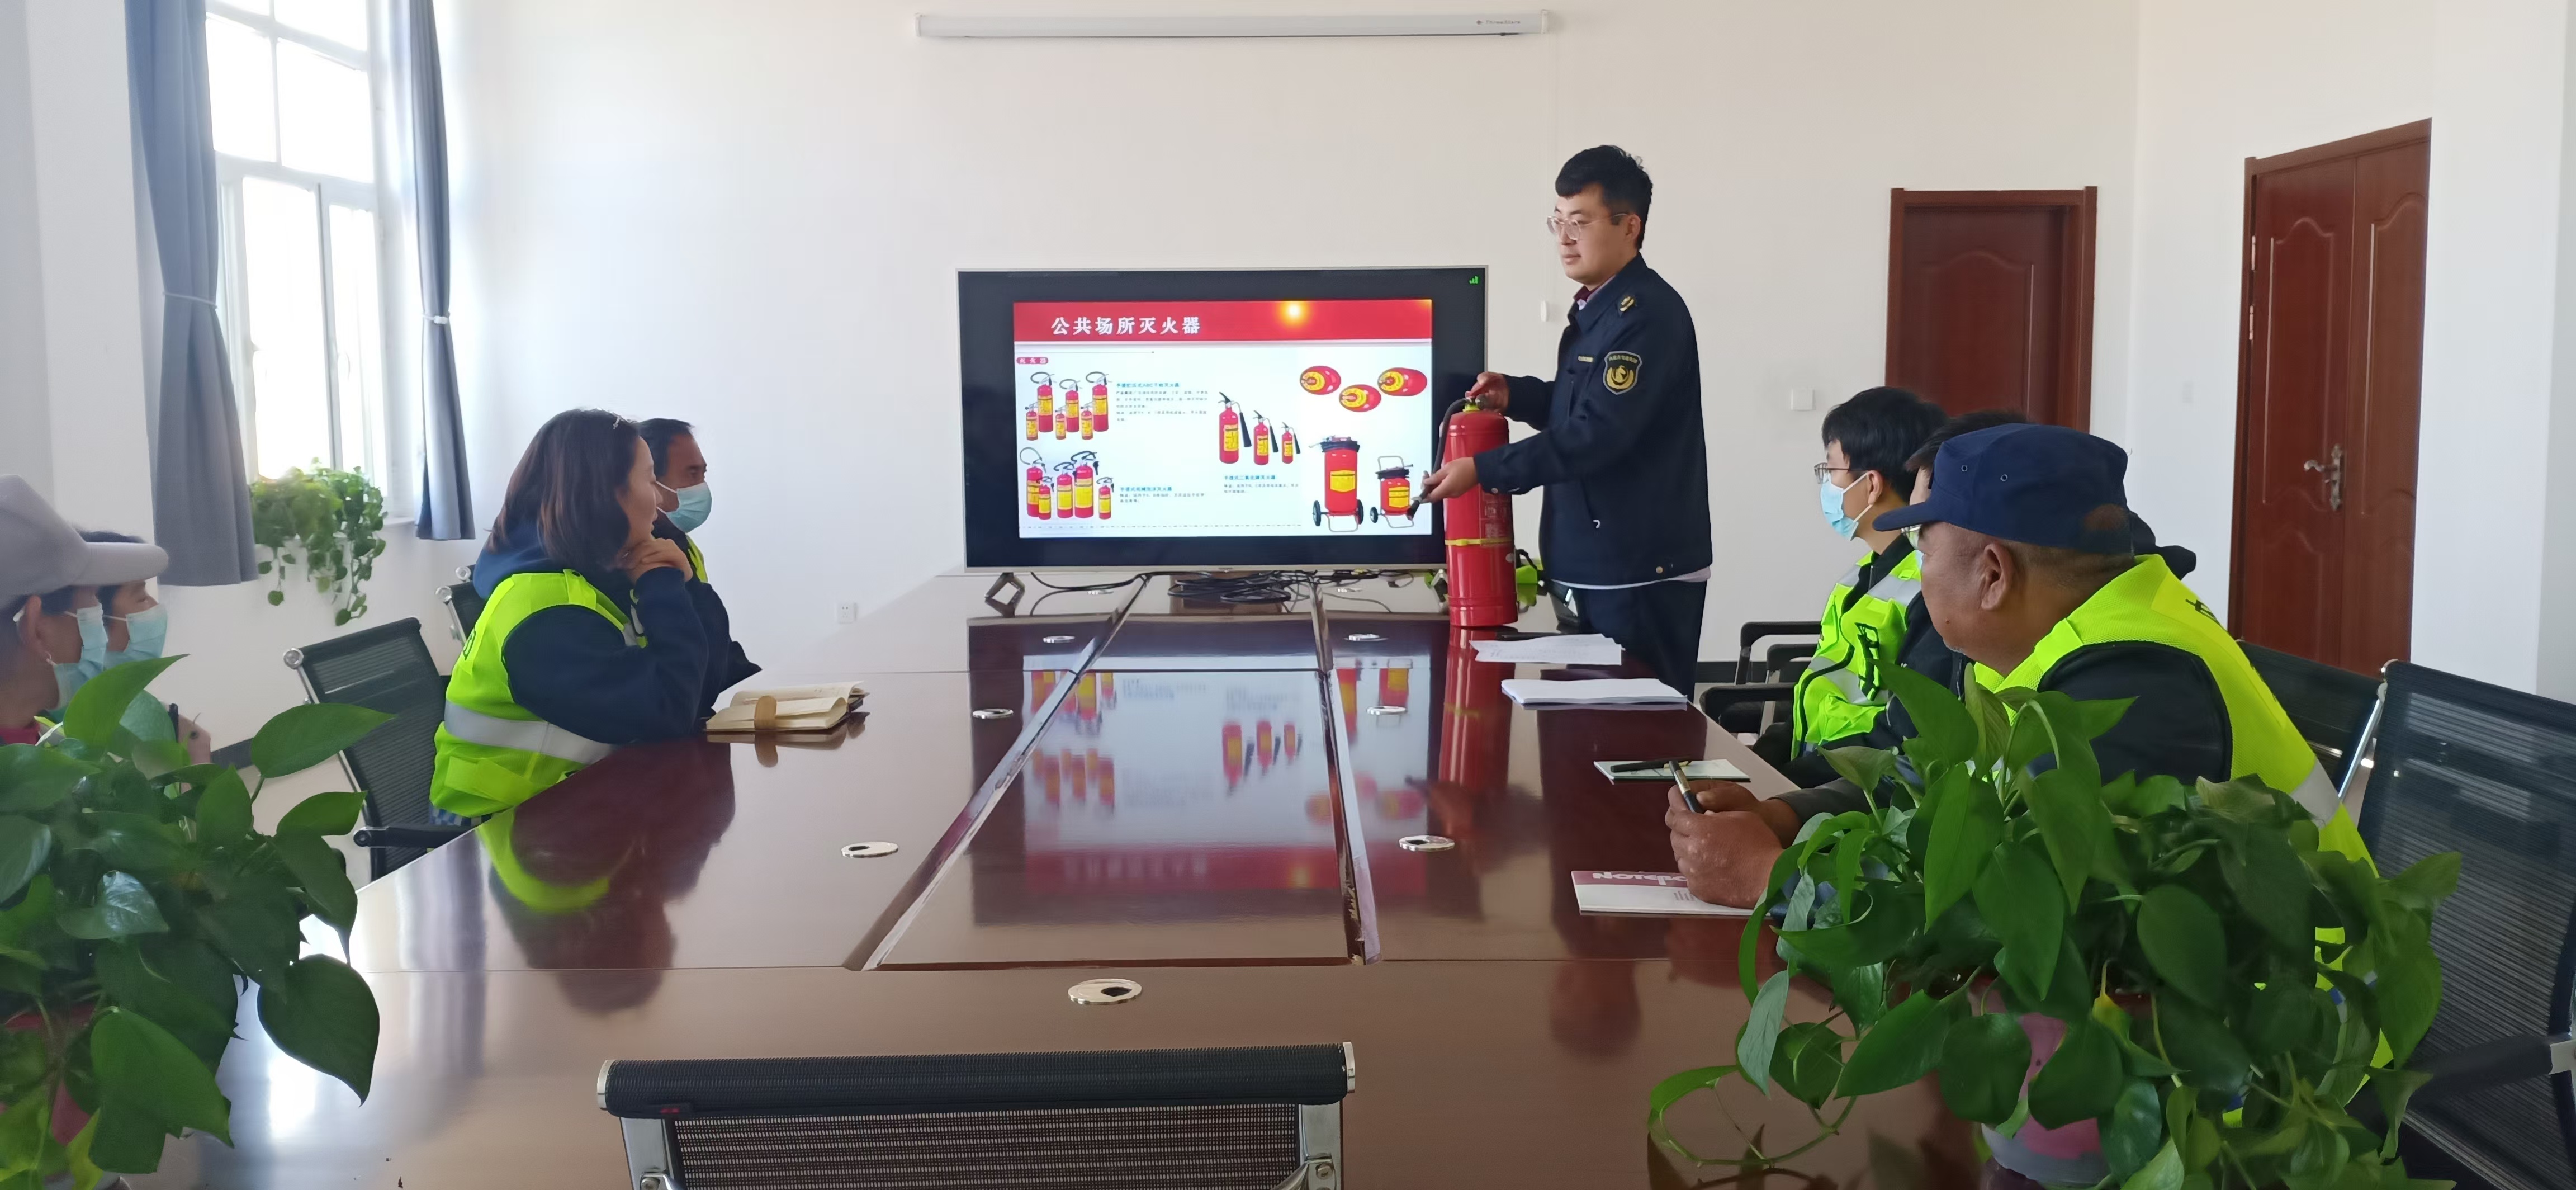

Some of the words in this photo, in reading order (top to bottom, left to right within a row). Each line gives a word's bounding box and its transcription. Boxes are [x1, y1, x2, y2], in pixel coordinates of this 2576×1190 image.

[1050, 316, 1201, 336] 公共场所灭火器
